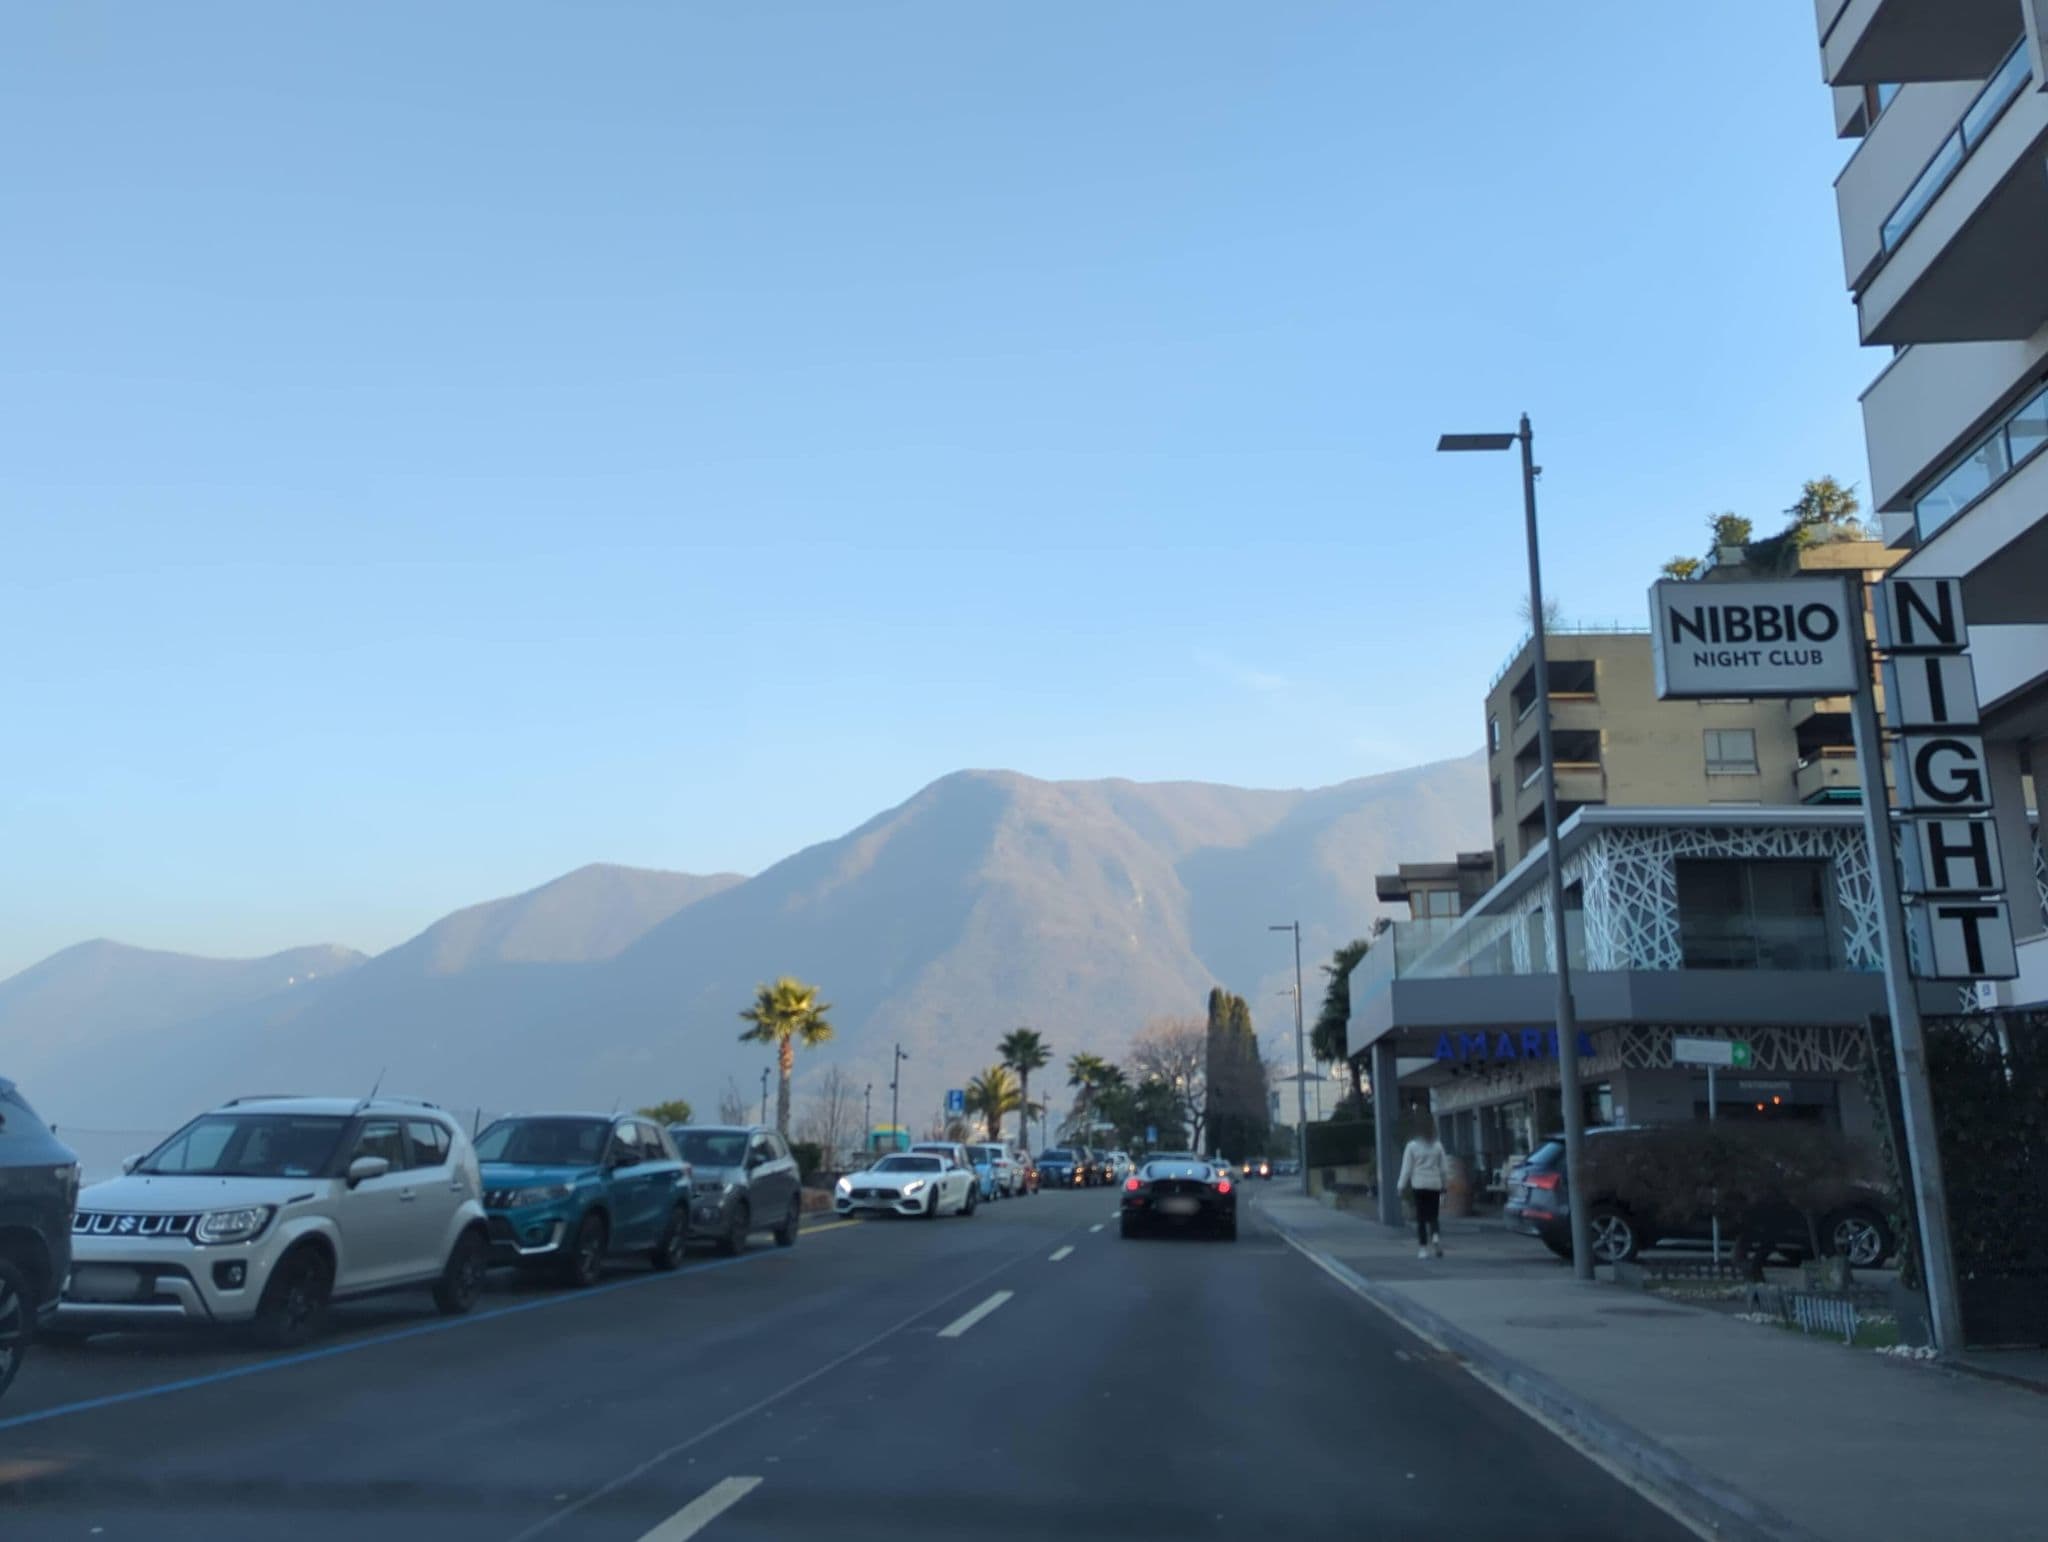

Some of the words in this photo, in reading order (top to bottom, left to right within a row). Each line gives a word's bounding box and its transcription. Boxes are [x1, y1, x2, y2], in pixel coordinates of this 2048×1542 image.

[1669, 603, 1839, 644] NIBBIO
[1694, 651, 1761, 667] NIGHT
[1769, 650, 1823, 666] CLUB
[1894, 580, 1999, 974] NIGHT
